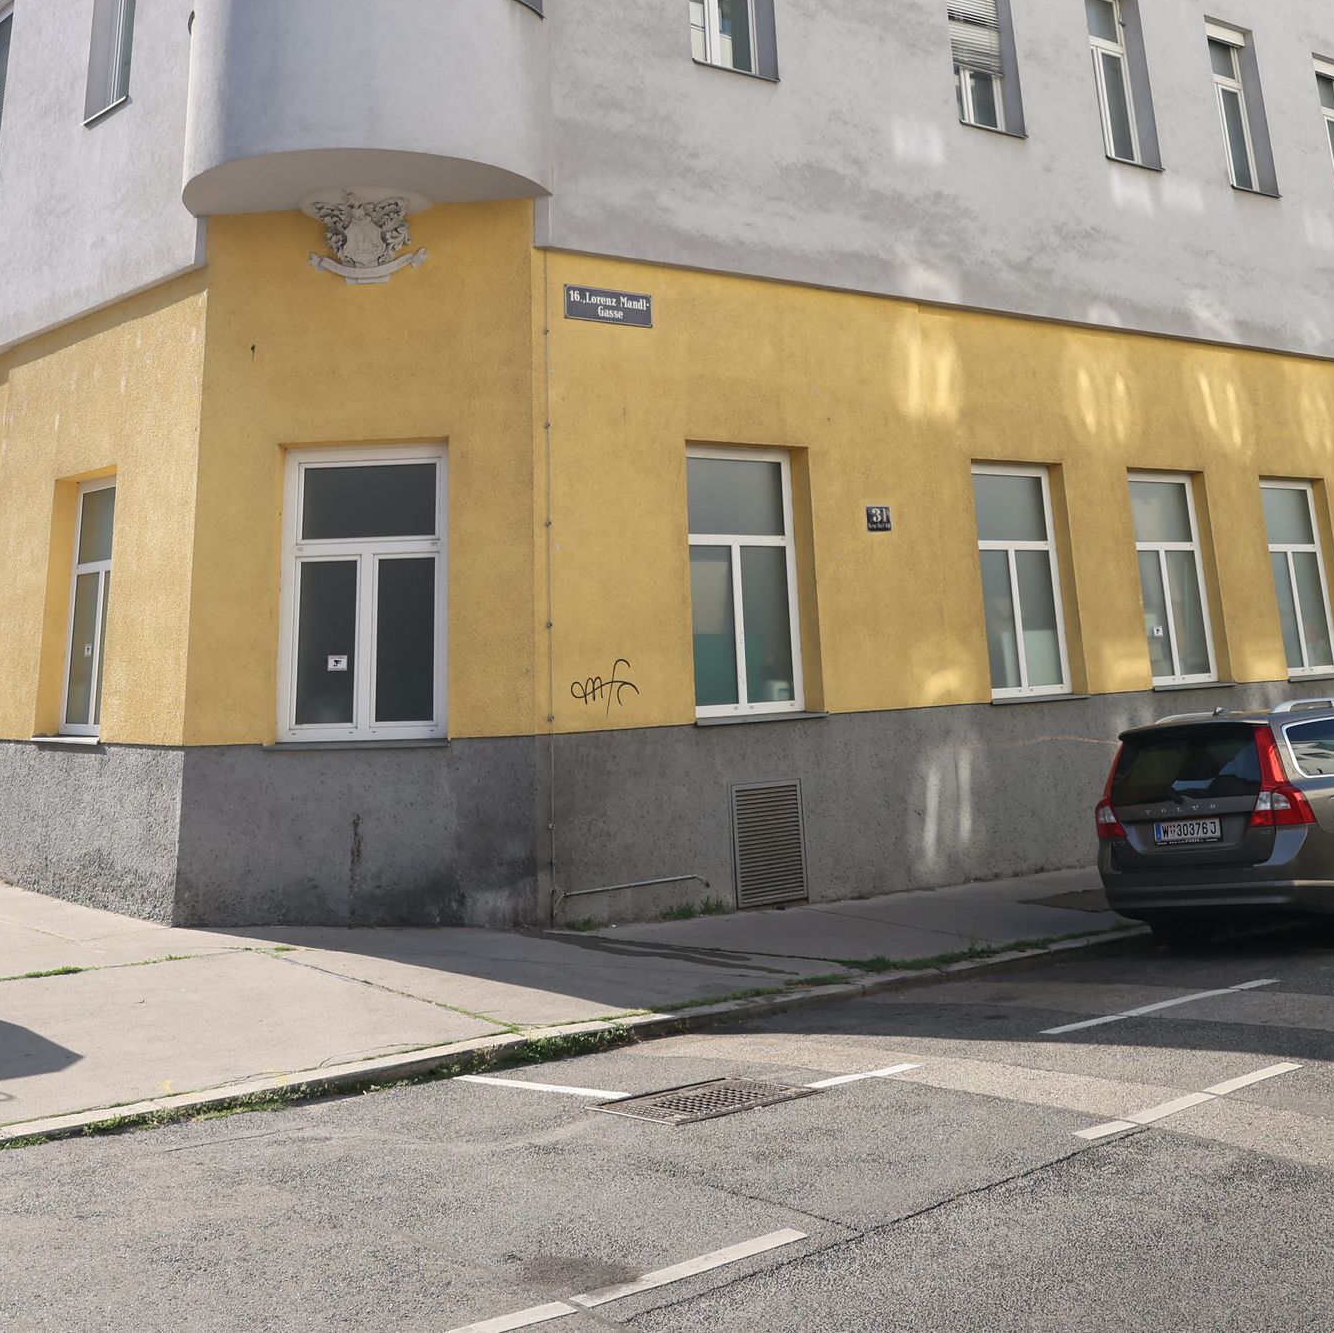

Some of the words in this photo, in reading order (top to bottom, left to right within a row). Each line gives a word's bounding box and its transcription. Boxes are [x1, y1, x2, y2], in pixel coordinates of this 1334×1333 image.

[597, 306, 624, 319] Gasse
[872, 508, 887, 522] 31
[1145, 803, 1216, 815] VOLVO
